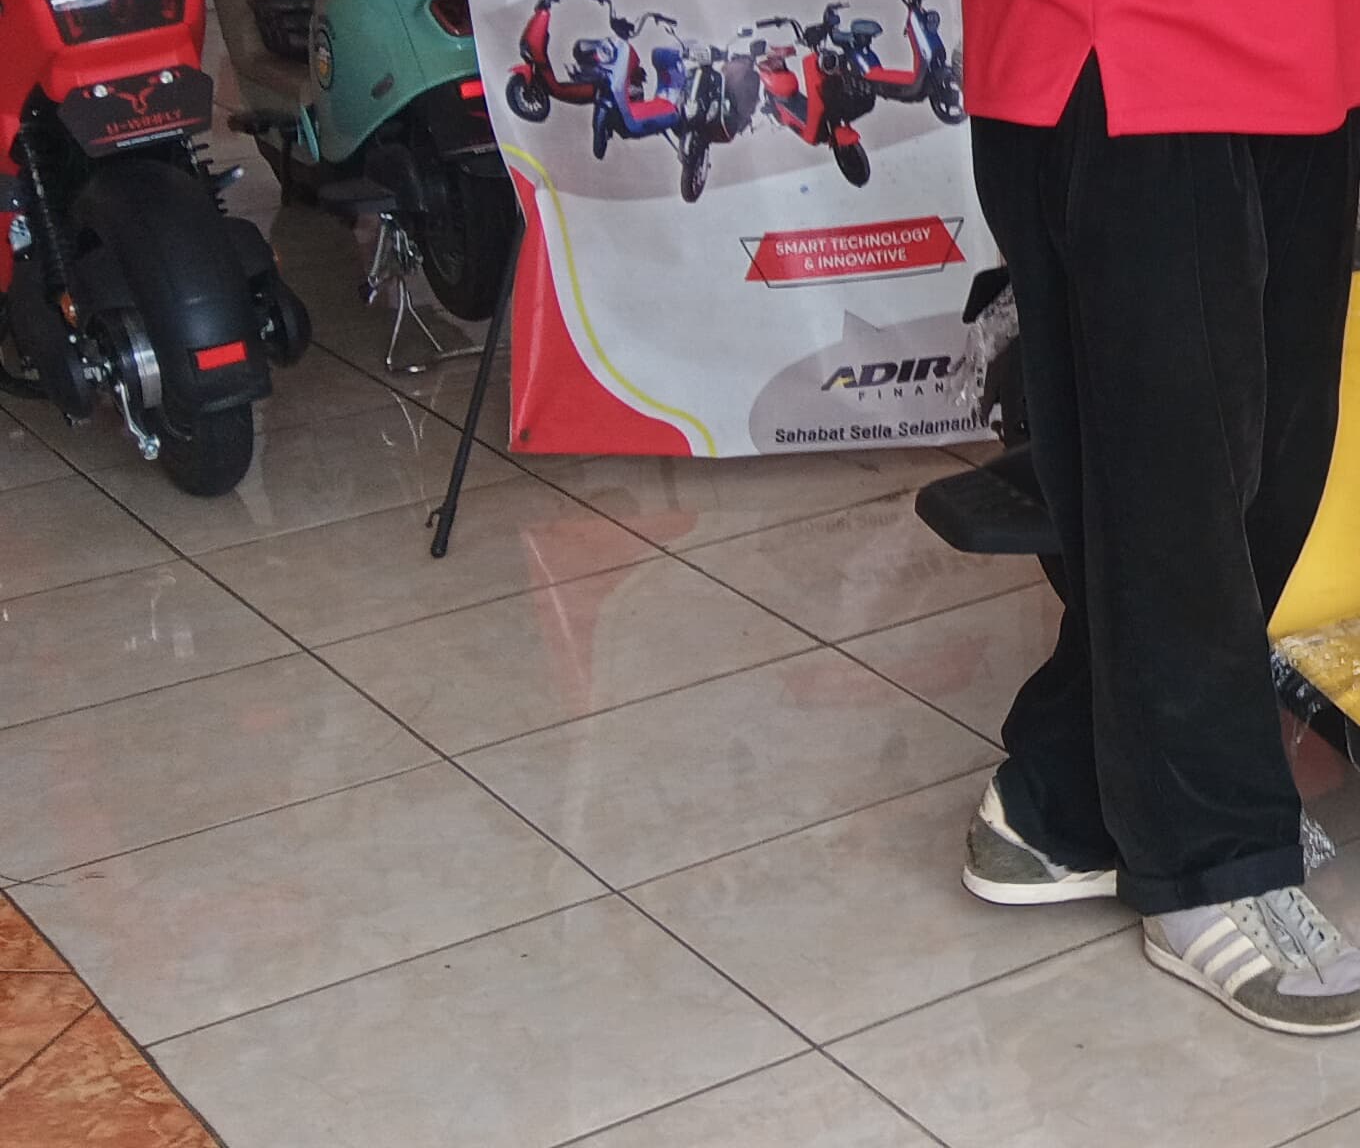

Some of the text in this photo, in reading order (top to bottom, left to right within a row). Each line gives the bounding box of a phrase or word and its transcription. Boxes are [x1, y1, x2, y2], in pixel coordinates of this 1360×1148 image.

[775, 227, 932, 256] SMART TECHNOLOGY
[804, 247, 907, 271] & INNOVATIVE
[774, 425, 845, 444] Sahabat
[850, 422, 892, 440] Setia
